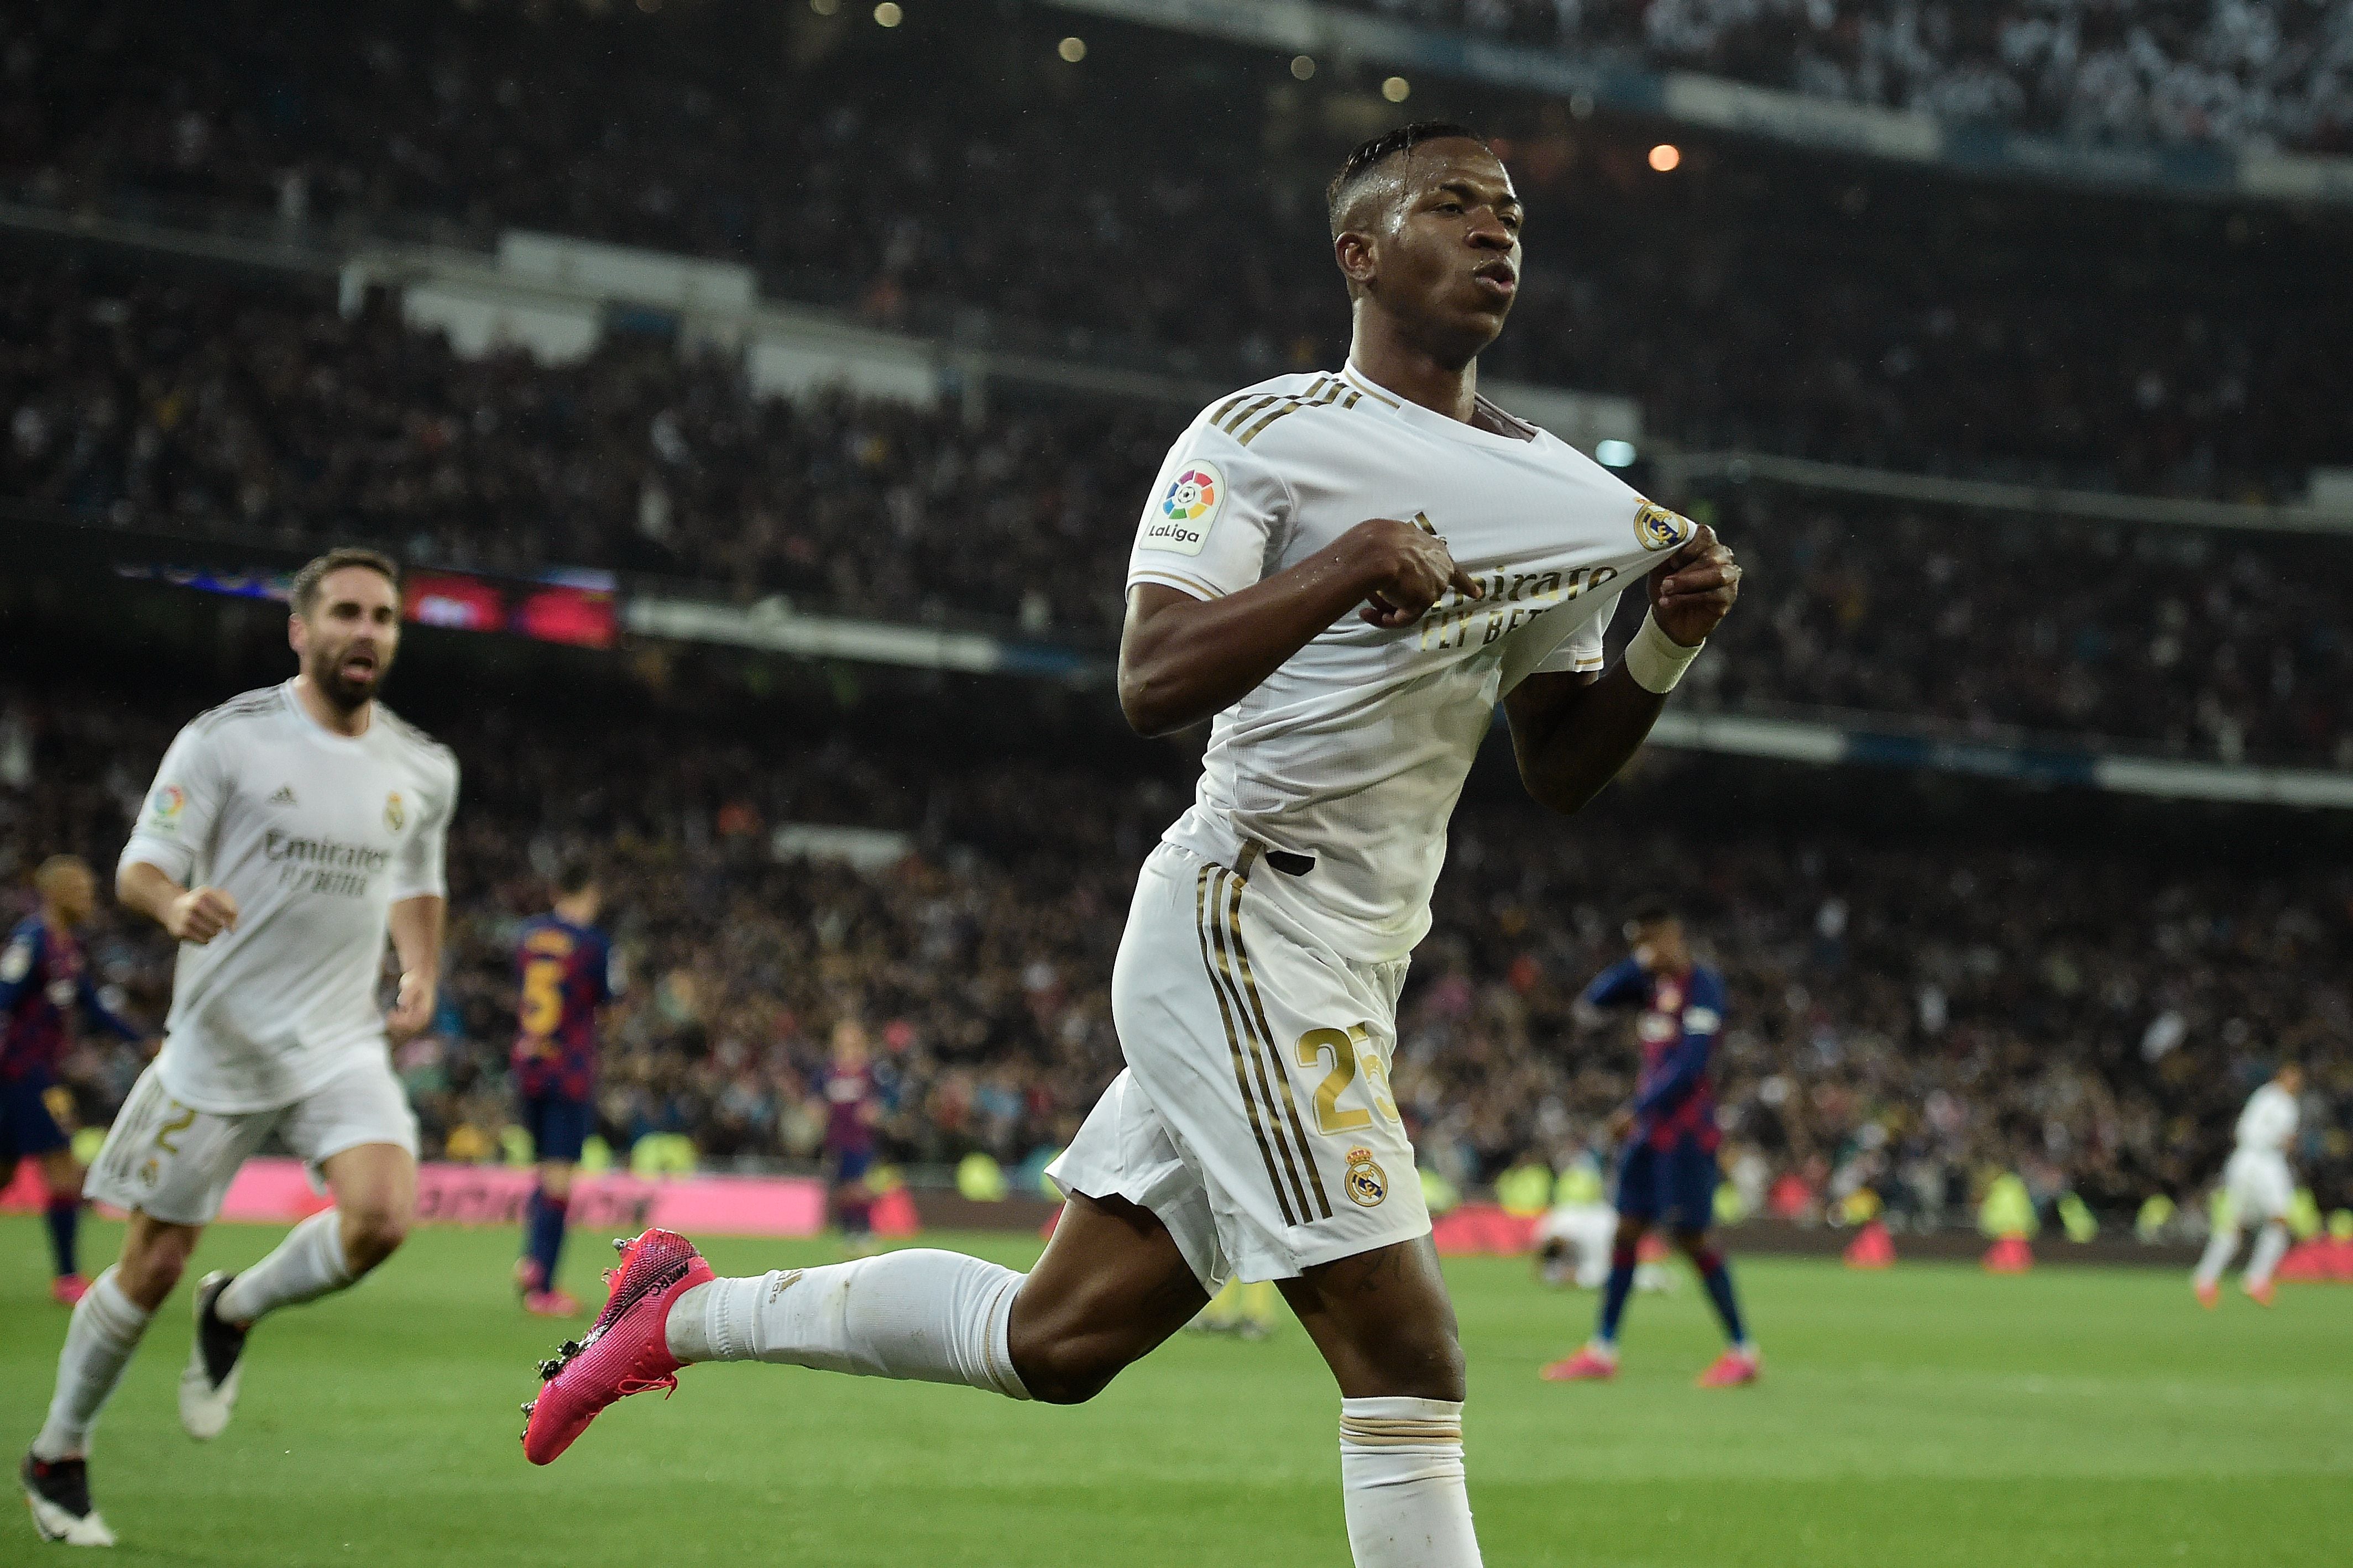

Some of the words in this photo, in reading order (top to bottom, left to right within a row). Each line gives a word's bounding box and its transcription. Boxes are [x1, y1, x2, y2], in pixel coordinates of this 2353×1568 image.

[1148, 523, 1200, 543] LaLiga
[519, 958, 565, 1036] 5
[154, 1099, 198, 1155] 2
